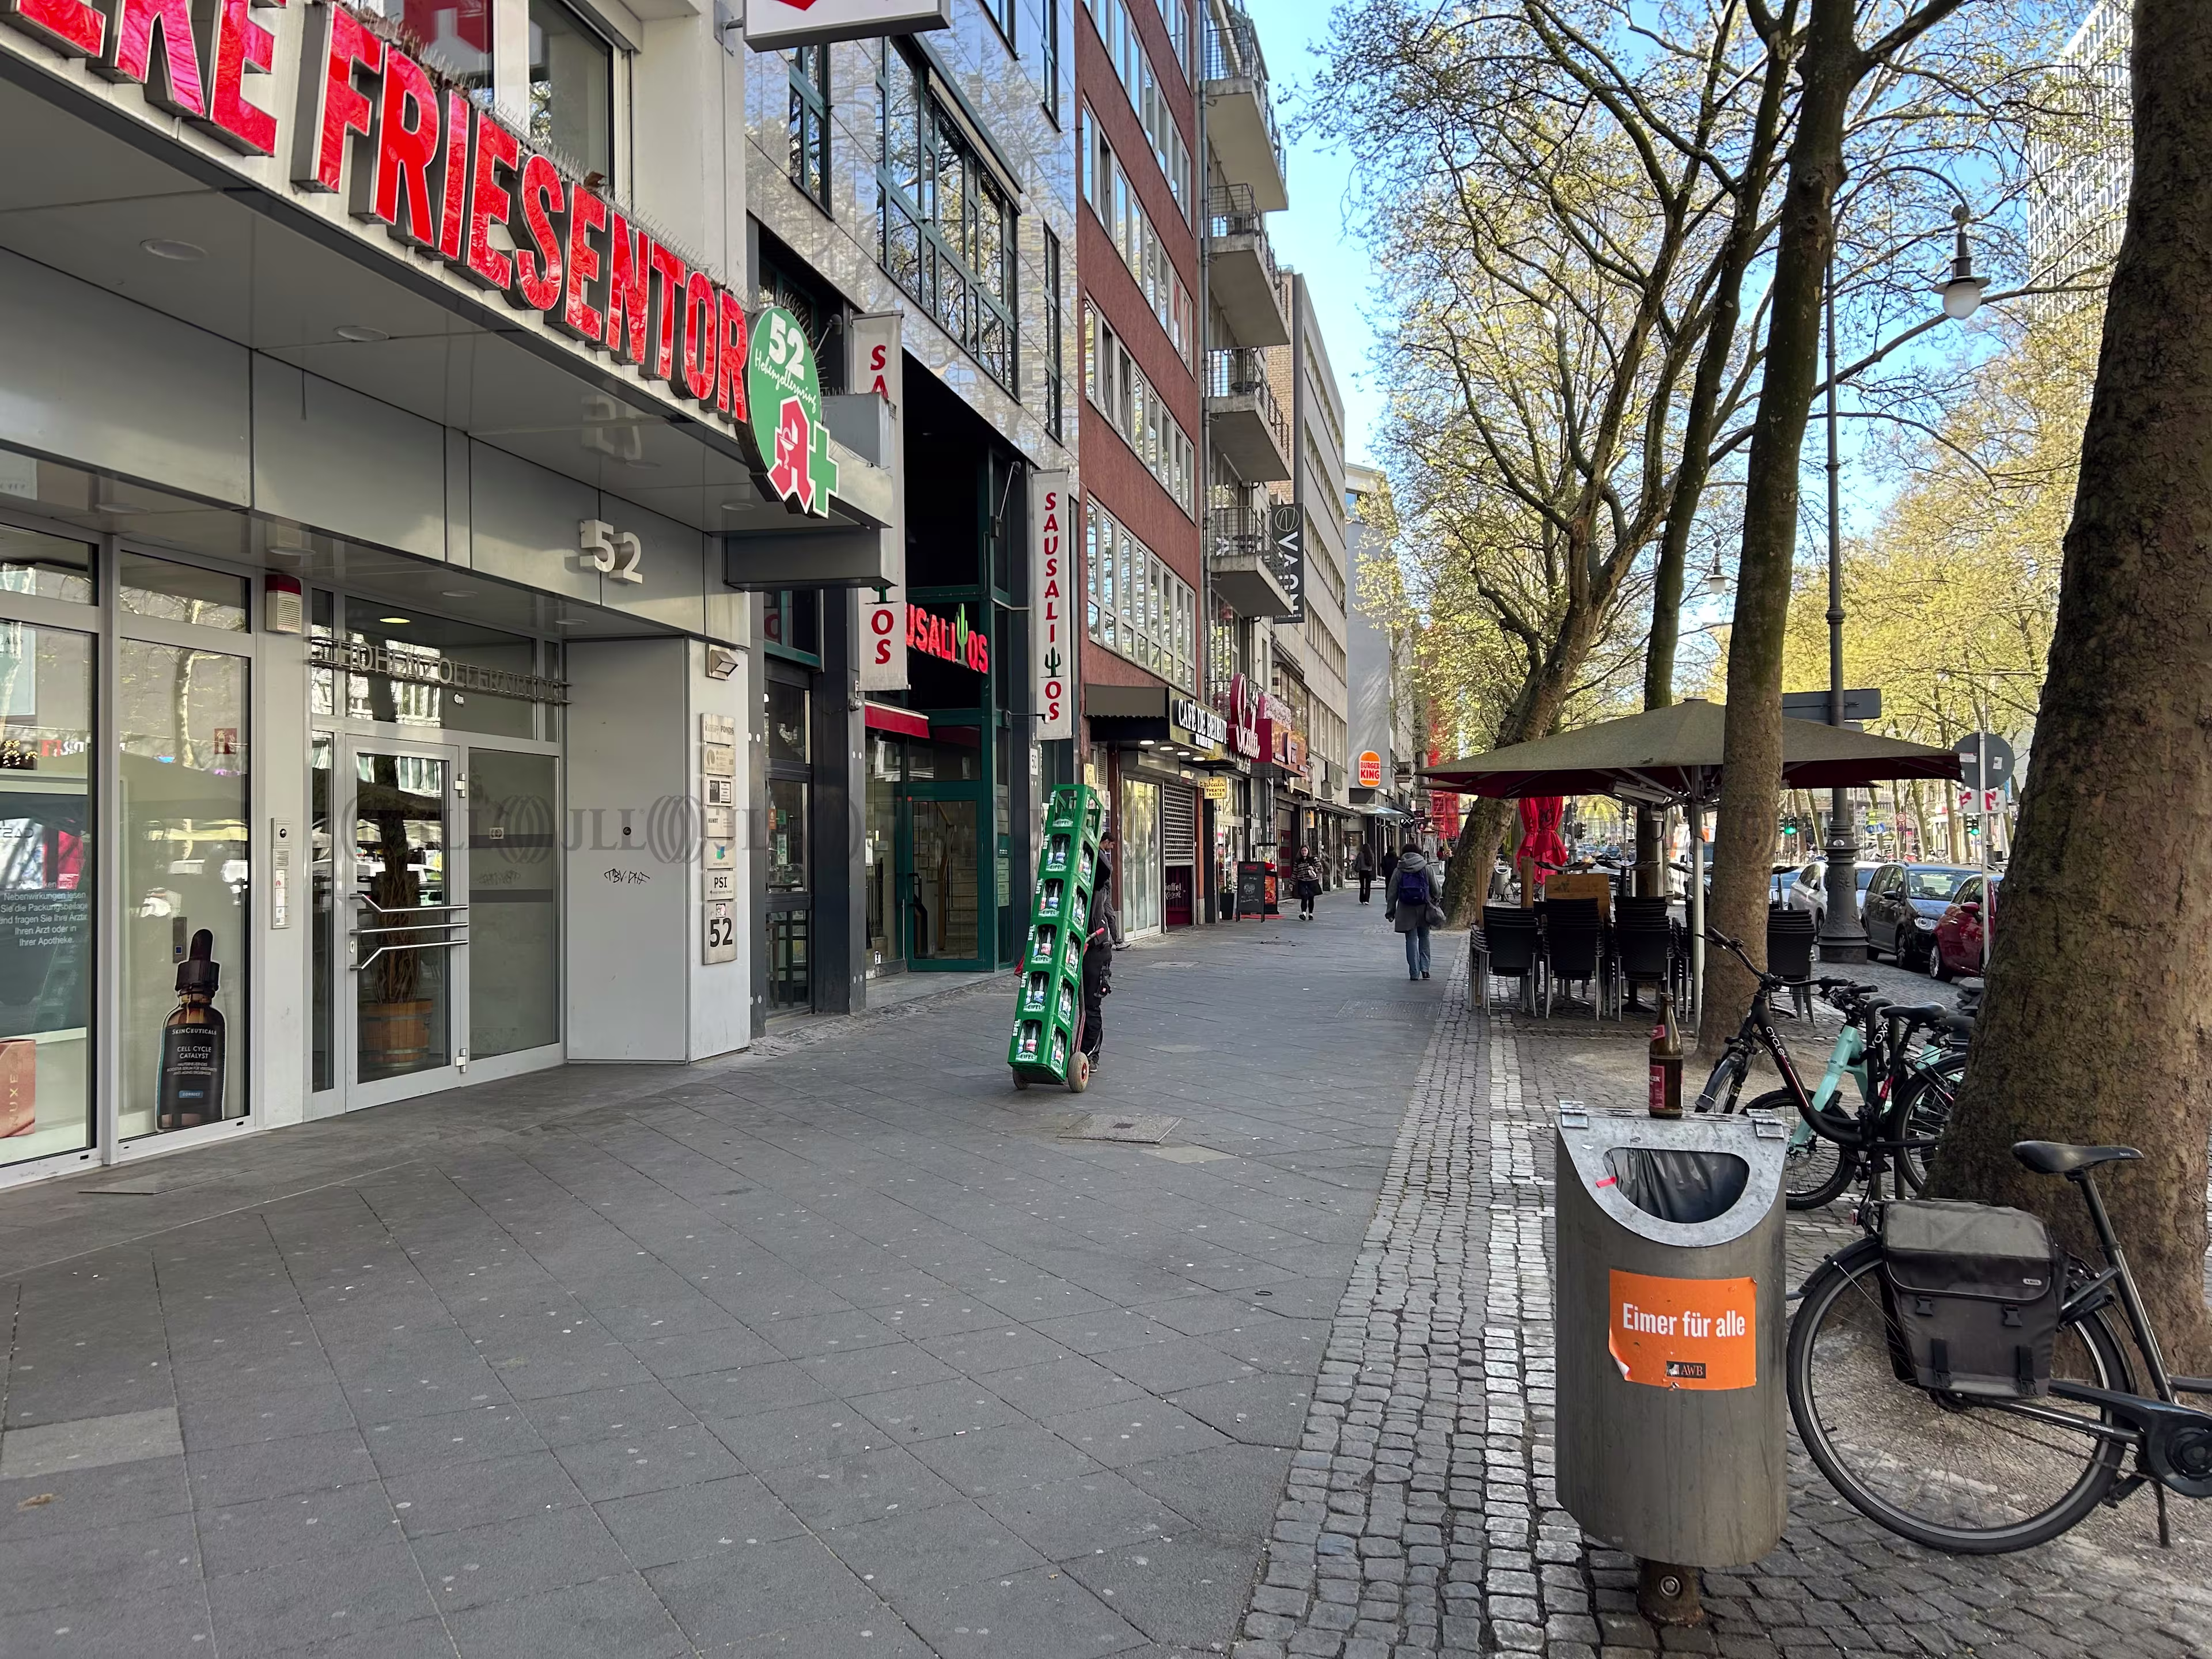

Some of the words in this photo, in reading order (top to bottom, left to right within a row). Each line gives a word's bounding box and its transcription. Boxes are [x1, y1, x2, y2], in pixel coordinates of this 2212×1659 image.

[315, 2, 748, 424] FRIESENTOR
[768, 312, 805, 381] 52
[755, 347, 817, 414] Hohenzollernring
[581, 519, 643, 584] 52
[1178, 698, 1196, 732] CAFÉ
[1196, 707, 1206, 735] DE
[1206, 712, 1228, 745] BEIRUT
[1236, 673, 1261, 760] Scala
[1360, 762, 1380, 770] BURGER
[1361, 769, 1380, 779] KING
[1207, 778, 1225, 787] Scala
[714, 877, 728, 888] PSI
[1035, 878, 1044, 895] EIFEL
[3, 893, 66, 902] Nebenwirkungen
[0, 904, 13, 913] Sie
[14, 904, 26, 912] die
[28, 903, 89, 912] Packungsbeilage
[15, 915, 39, 925] fragen
[40, 914, 52, 922] Sie
[54, 914, 68, 922] Ihre
[15, 927, 33, 935] Ihren
[35, 926, 50, 935] Arzt
[710, 918, 733, 948] 52
[1028, 924, 1036, 941] EIFEL
[19, 938, 36, 946] Ihrer
[37, 936, 75, 947] Apotheke.
[1020, 971, 1029, 988] EIFEL
[1012, 1018, 1021, 1037] EIFEL
[9, 1074, 19, 1126] NUXE
[1623, 1302, 1677, 1336] Eimer
[1682, 1310, 1711, 1338] für
[1715, 1309, 1746, 1338] alle
[1680, 1363, 1704, 1377] AWB
